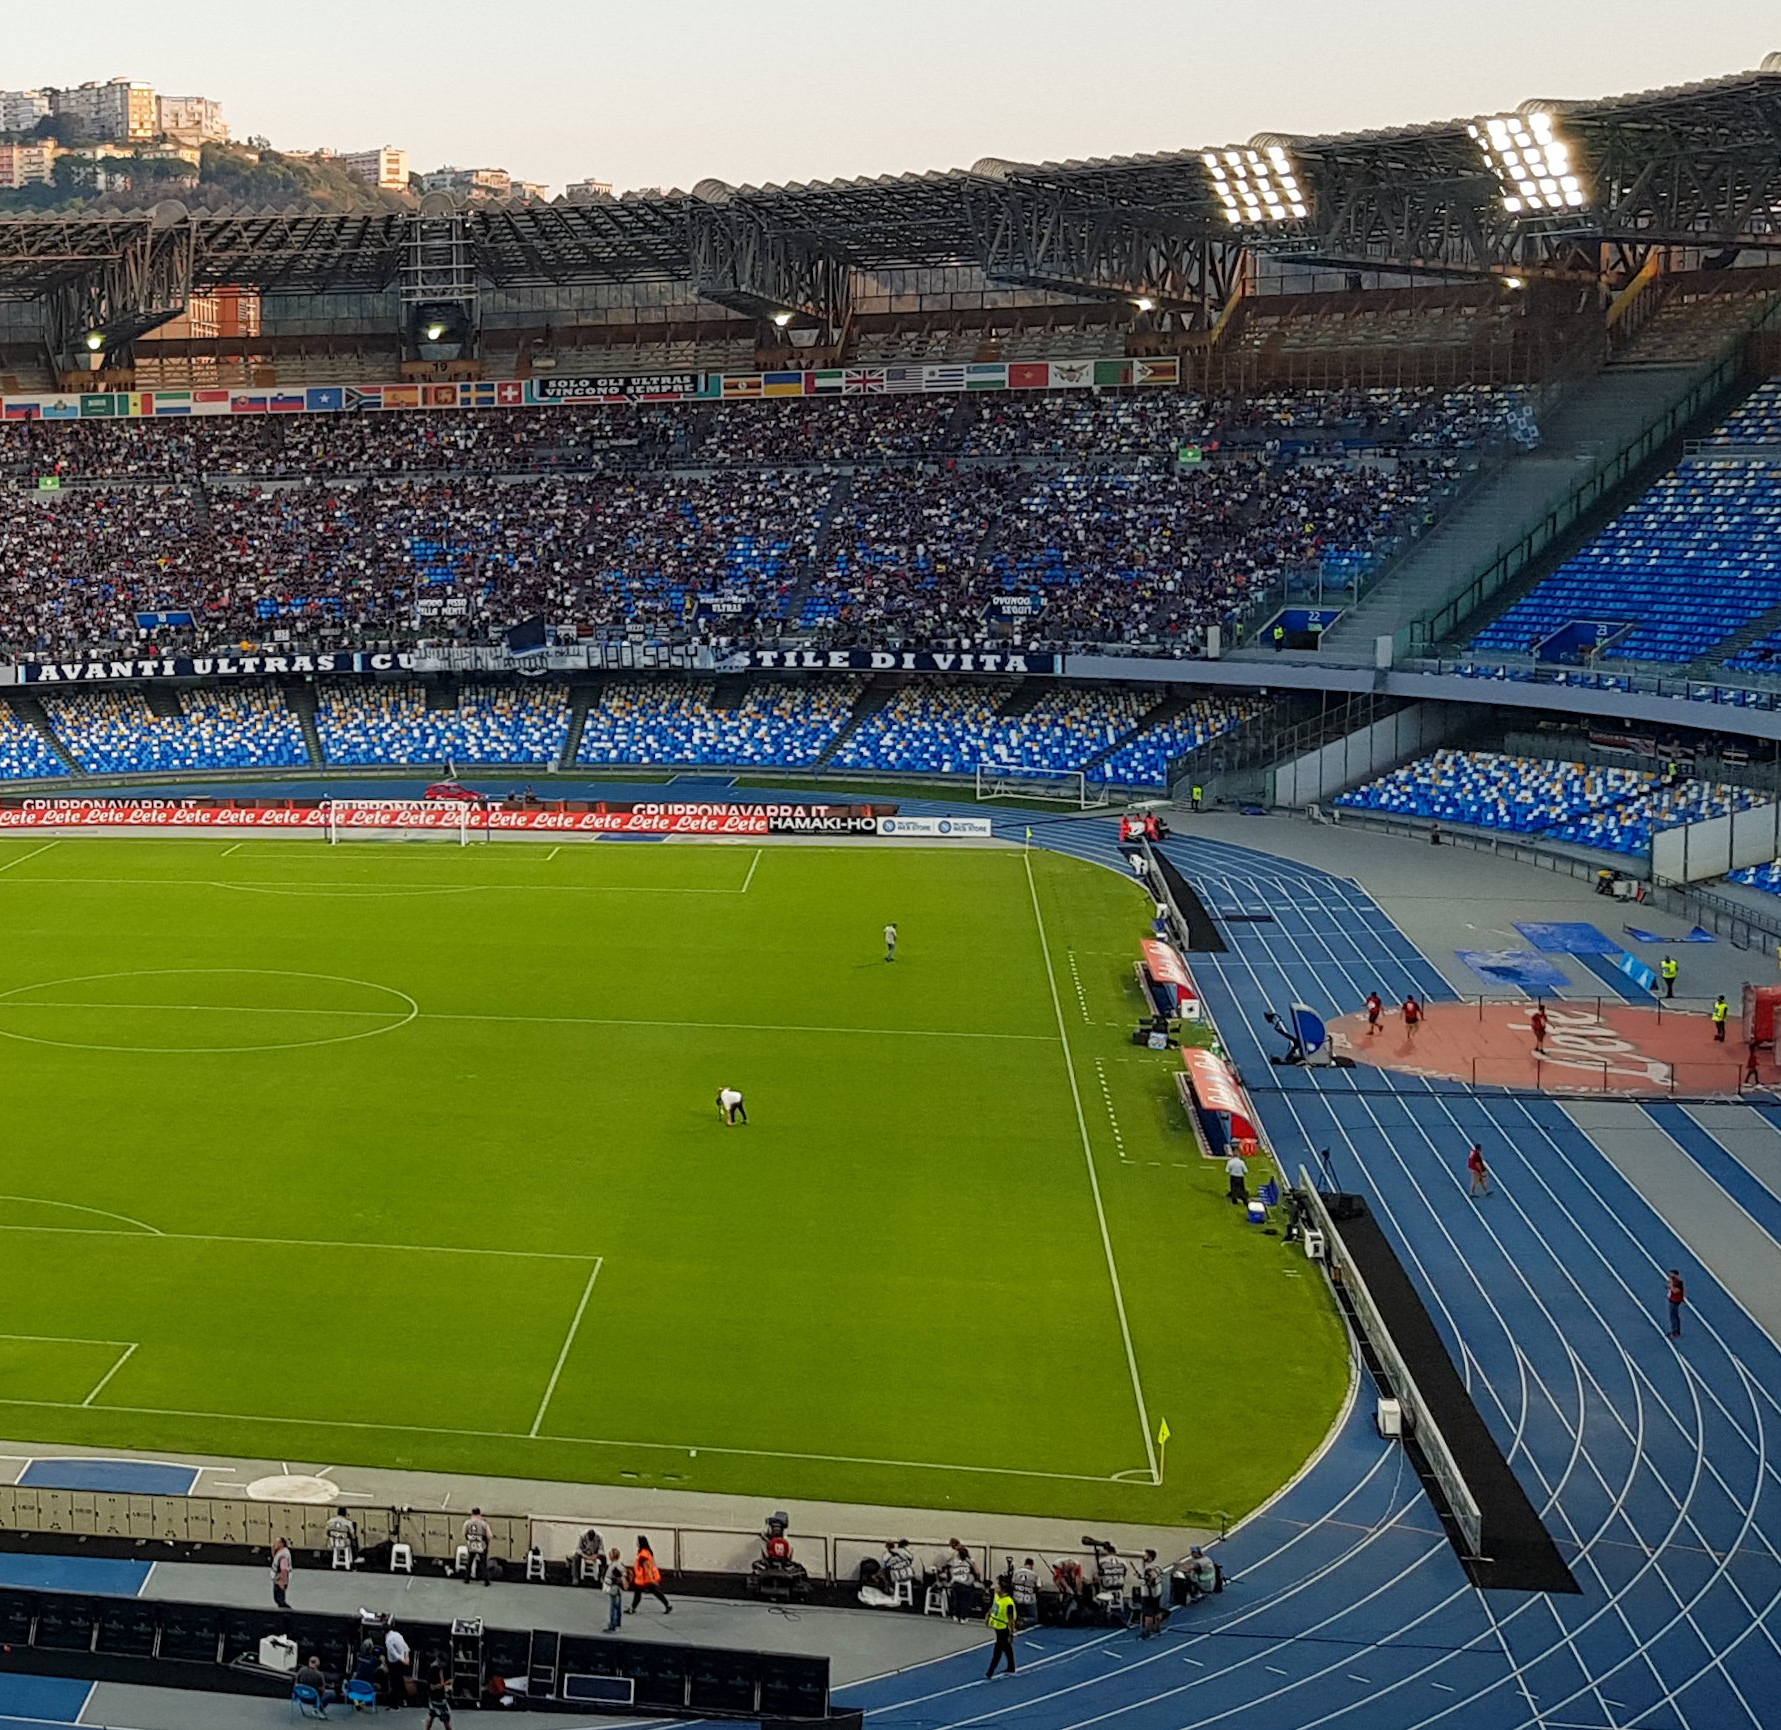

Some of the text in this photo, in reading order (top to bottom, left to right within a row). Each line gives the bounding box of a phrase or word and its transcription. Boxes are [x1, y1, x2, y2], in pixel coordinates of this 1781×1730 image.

[548, 375, 692, 388] SOLO GLI ULTRAS
[545, 384, 695, 397] VINCONO SEMPRE
[1308, 611, 1320, 622] 22
[38, 660, 176, 682] AVANTI
[192, 653, 335, 676] ULTRAS
[870, 652, 917, 669] DI
[931, 653, 1028, 672] VITA
[23, 799, 197, 810] GRUPPONAVARRAIT
[632, 803, 829, 817] GRUPPONAVARRAIT
[37, 810, 80, 825] Lete
[81, 809, 124, 824] Lete
[125, 808, 167, 824] Lete
[168, 808, 210, 824] Lete
[212, 809, 255, 824] Lete
[257, 809, 300, 825] Lete
[347, 810, 391, 826] Lete
[391, 810, 435, 826] Lete
[483, 812, 527, 827] Lete
[528, 812, 574, 828] Lete
[575, 813, 621, 828] Lete
[623, 814, 670, 830] Lete
[671, 815, 718, 831] Lete
[719, 816, 766, 832] Lete
[770, 817, 877, 831] HAMAKI-HO
